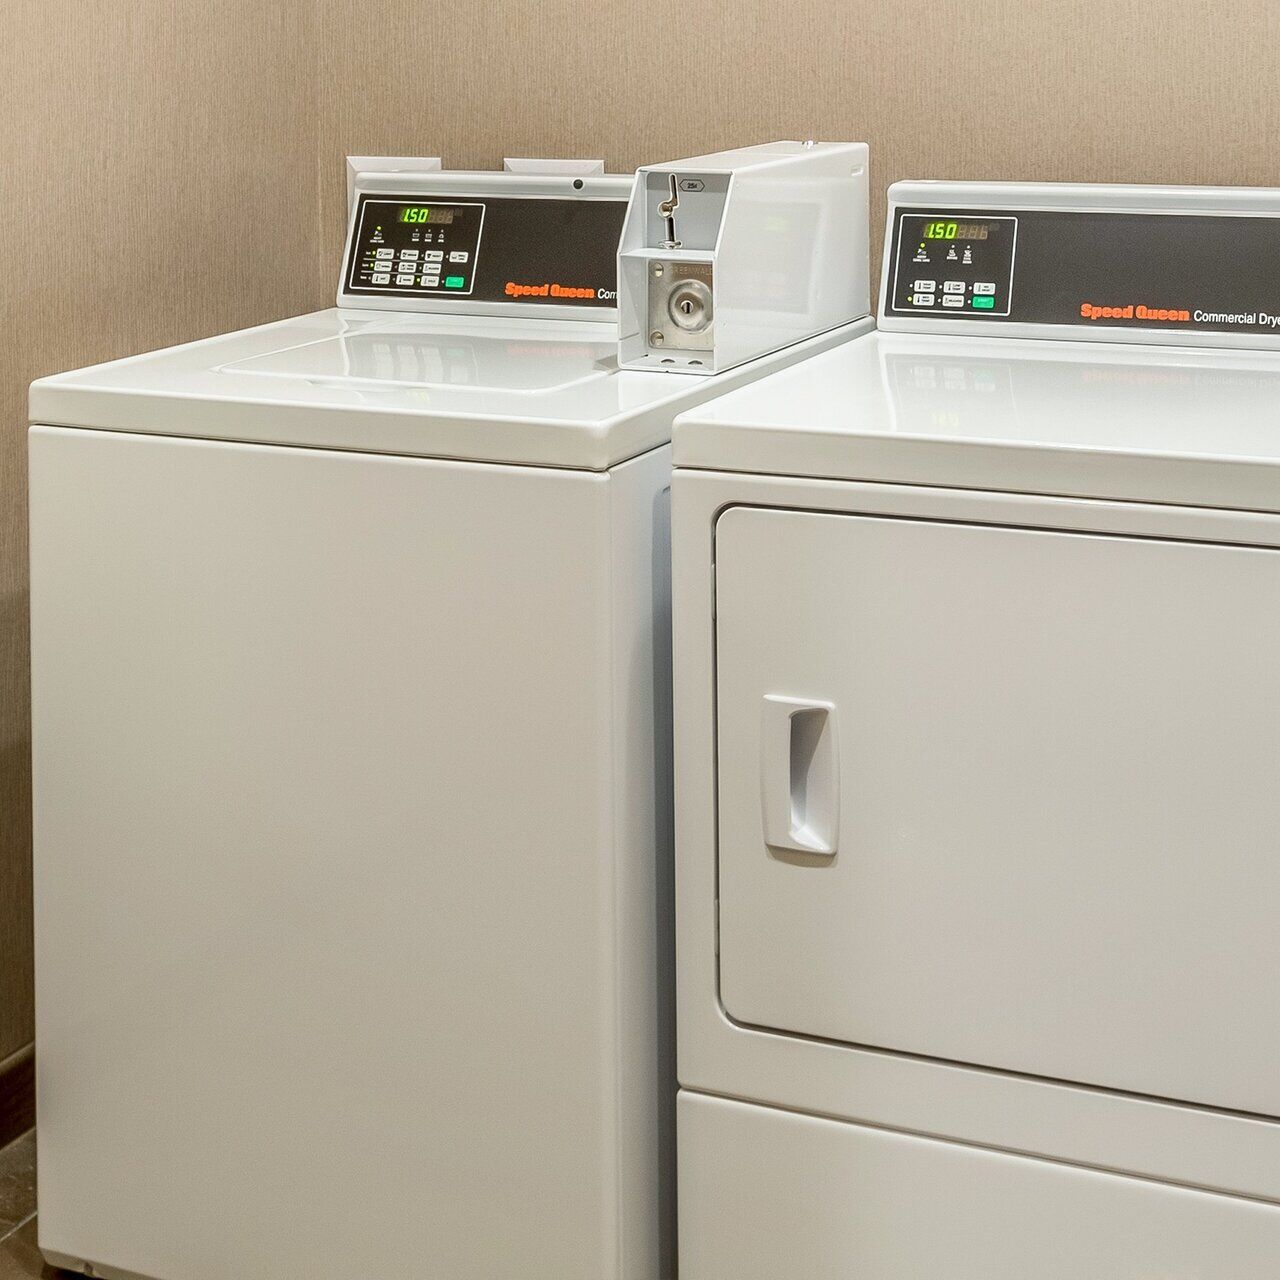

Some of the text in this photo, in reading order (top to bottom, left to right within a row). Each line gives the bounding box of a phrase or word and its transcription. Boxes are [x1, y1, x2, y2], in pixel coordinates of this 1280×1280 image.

[504, 282, 549, 297] Speed
[550, 284, 595, 298] Queen
[1080, 303, 1134, 320] Speed
[1135, 305, 1190, 321] Queen
[1193, 310, 1256, 324] Commercial
